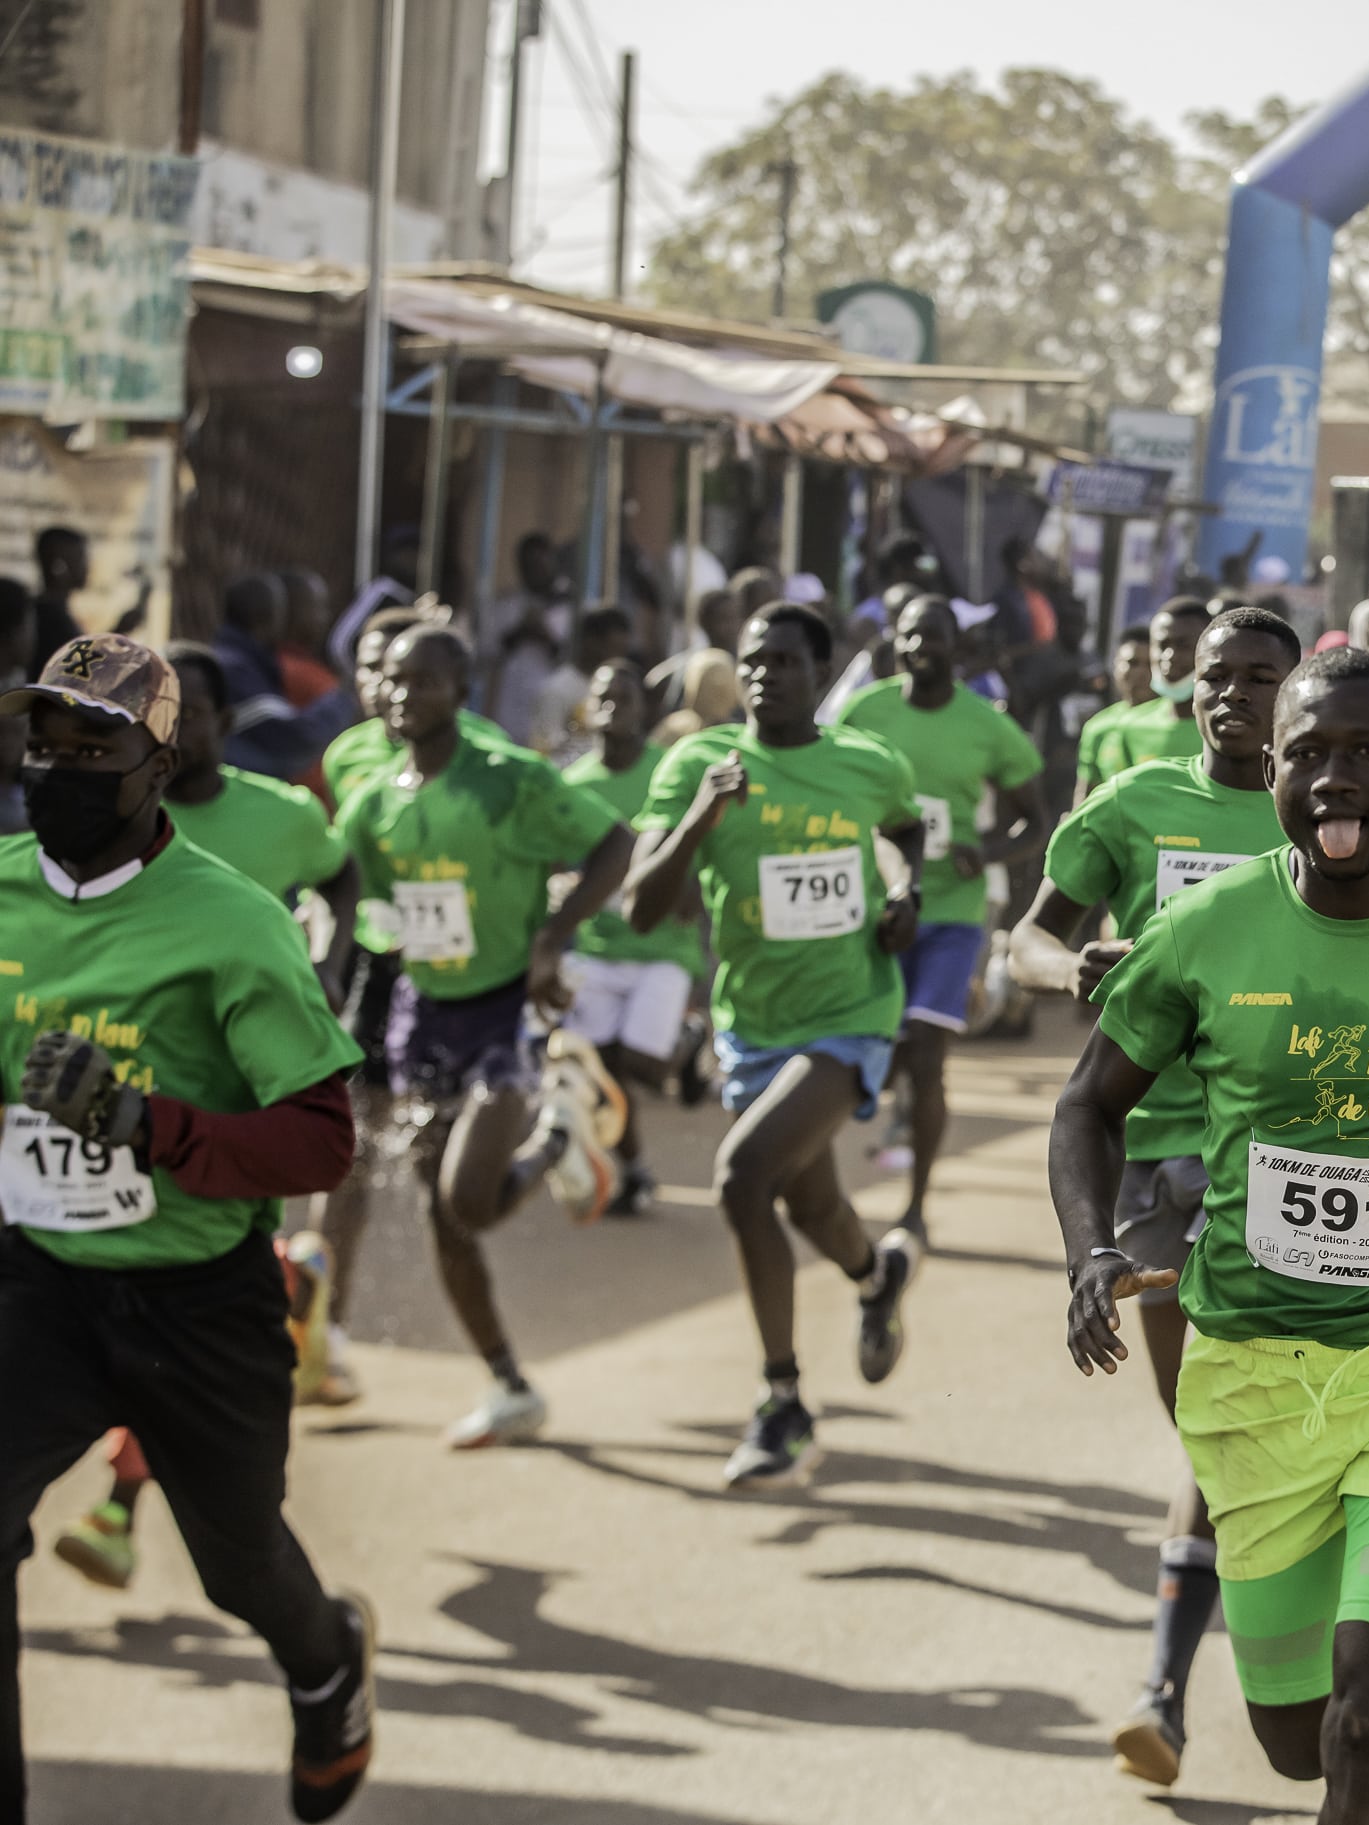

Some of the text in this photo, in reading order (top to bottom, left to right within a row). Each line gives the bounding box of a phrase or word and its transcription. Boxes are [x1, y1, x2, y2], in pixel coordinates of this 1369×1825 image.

[784, 872, 850, 902] 790
[1228, 992, 1293, 1006] PANGA
[1288, 1024, 1325, 1058] Lafi
[1337, 1094, 1367, 1121] de
[25, 1136, 113, 1177] 179
[1267, 1157, 1362, 1182] 10KM DE OUAGA
[1313, 1233, 1349, 1246] édition
